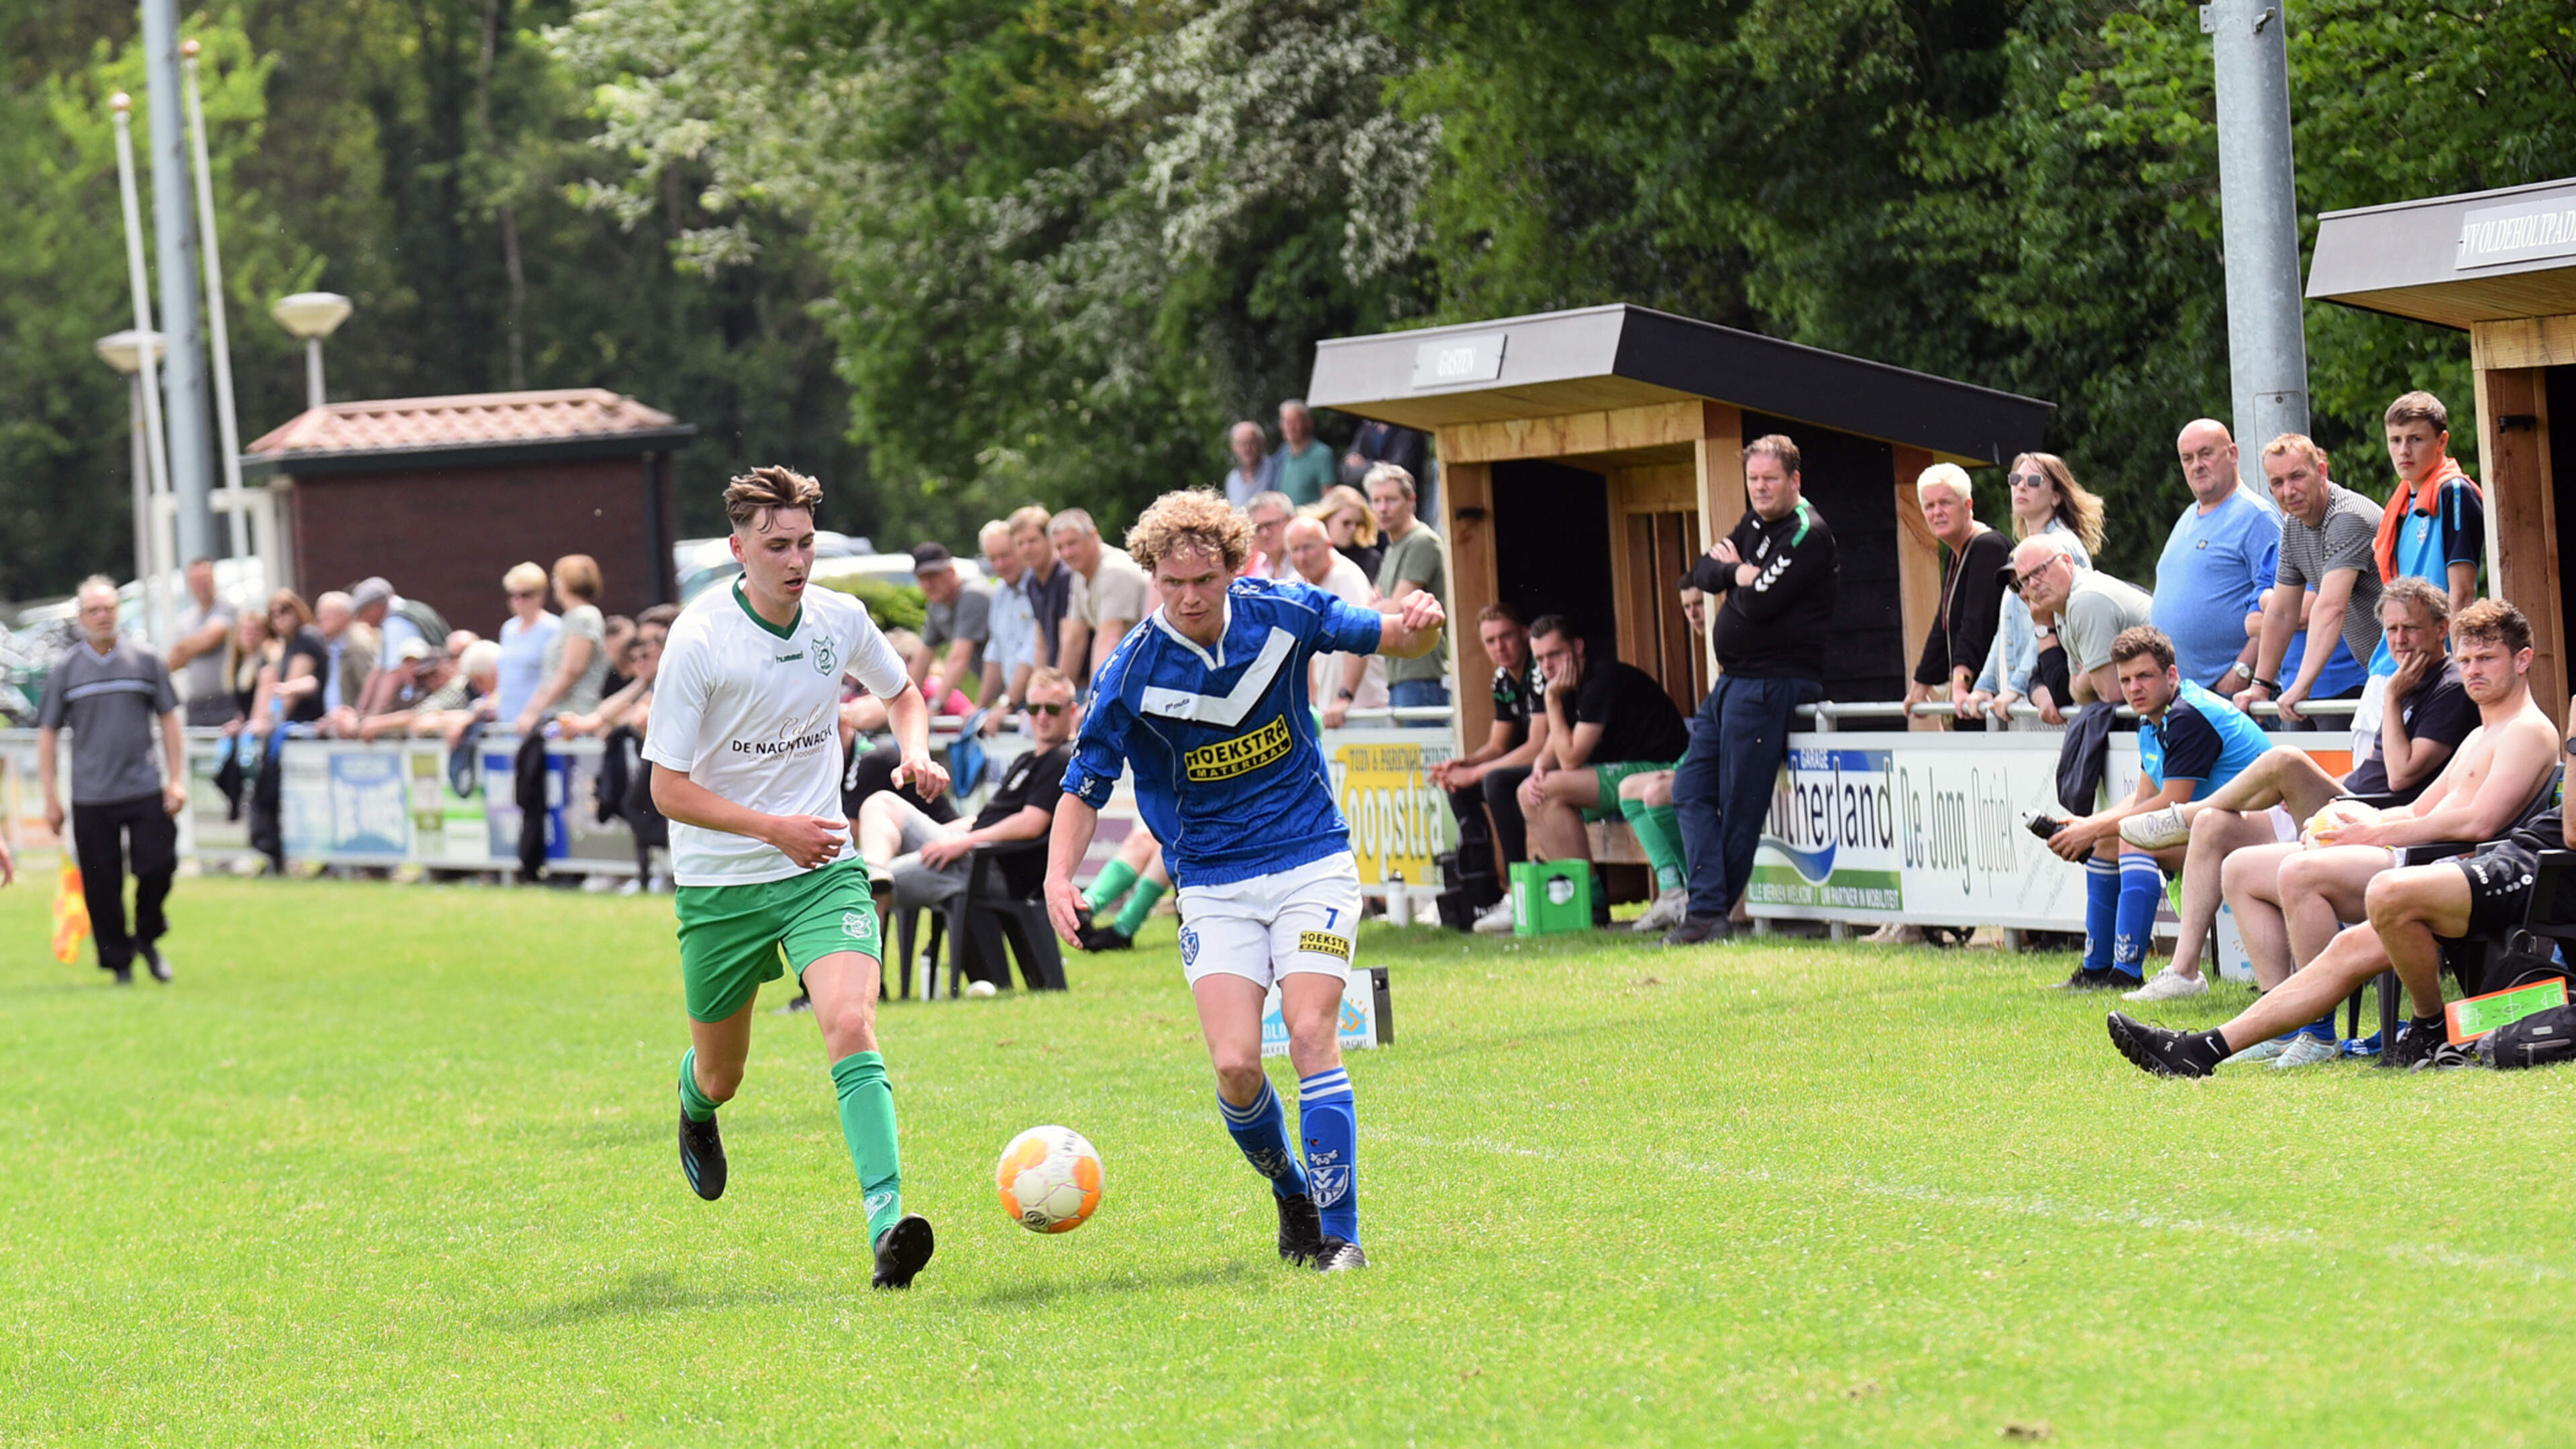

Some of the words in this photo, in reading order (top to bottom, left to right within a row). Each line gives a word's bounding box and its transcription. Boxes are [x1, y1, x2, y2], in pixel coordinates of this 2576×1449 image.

[2479, 210, 2576, 254] OLDEHOLTPAD
[732, 740, 751, 753] DE
[1186, 718, 1286, 767] HOEKSTRA
[1800, 749, 1829, 769] GARAGE
[1196, 744, 1287, 777] MATERIAAL
[1763, 756, 1894, 849] utherland
[1900, 766, 1923, 869] De
[1929, 766, 1971, 896] Jong
[1972, 766, 2019, 899] Optiek
[1326, 907, 1338, 929] 7
[1301, 933, 1349, 951] HOEKSTR
